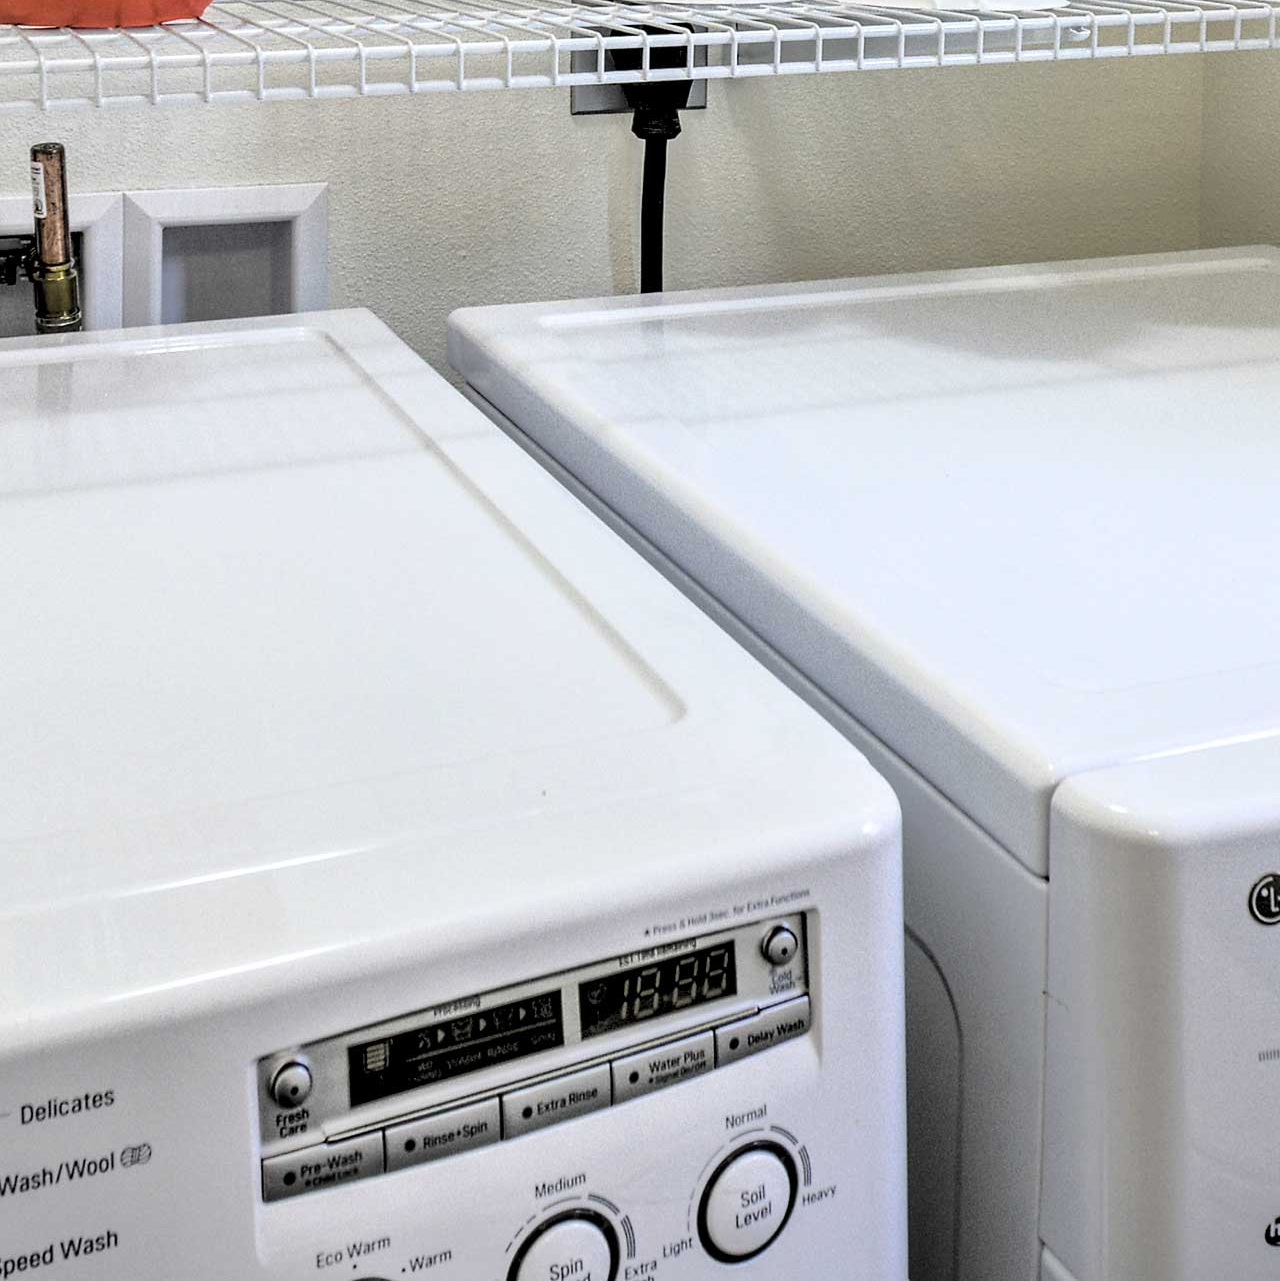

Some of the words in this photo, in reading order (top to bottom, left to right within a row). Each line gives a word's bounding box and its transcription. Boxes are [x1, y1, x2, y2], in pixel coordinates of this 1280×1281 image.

[747, 1028, 776, 1048] Delay
[776, 1019, 805, 1037] Wash
[648, 1055, 681, 1074] Water
[683, 1048, 706, 1066] Plus
[19, 1088, 116, 1126] Delicates
[536, 1096, 567, 1116] Extra
[568, 1086, 599, 1106] Rinse
[275, 1107, 310, 1128] Fresh
[724, 1103, 768, 1129] Normal
[279, 1122, 308, 1139] Care
[301, 1150, 363, 1178] Pre-Wash
[534, 1172, 587, 1199] Medium
[740, 1183, 767, 1209] Soil
[801, 1184, 838, 1207] Heavy
[735, 1202, 773, 1231] Level
[60, 1229, 119, 1261] Wash
[315, 1250, 344, 1269] Eco
[347, 1235, 392, 1259] Warm
[662, 1237, 693, 1259] Light
[409, 1249, 453, 1273] Warm
[549, 1258, 584, 1281] Spin
[624, 1259, 657, 1280] Extra
